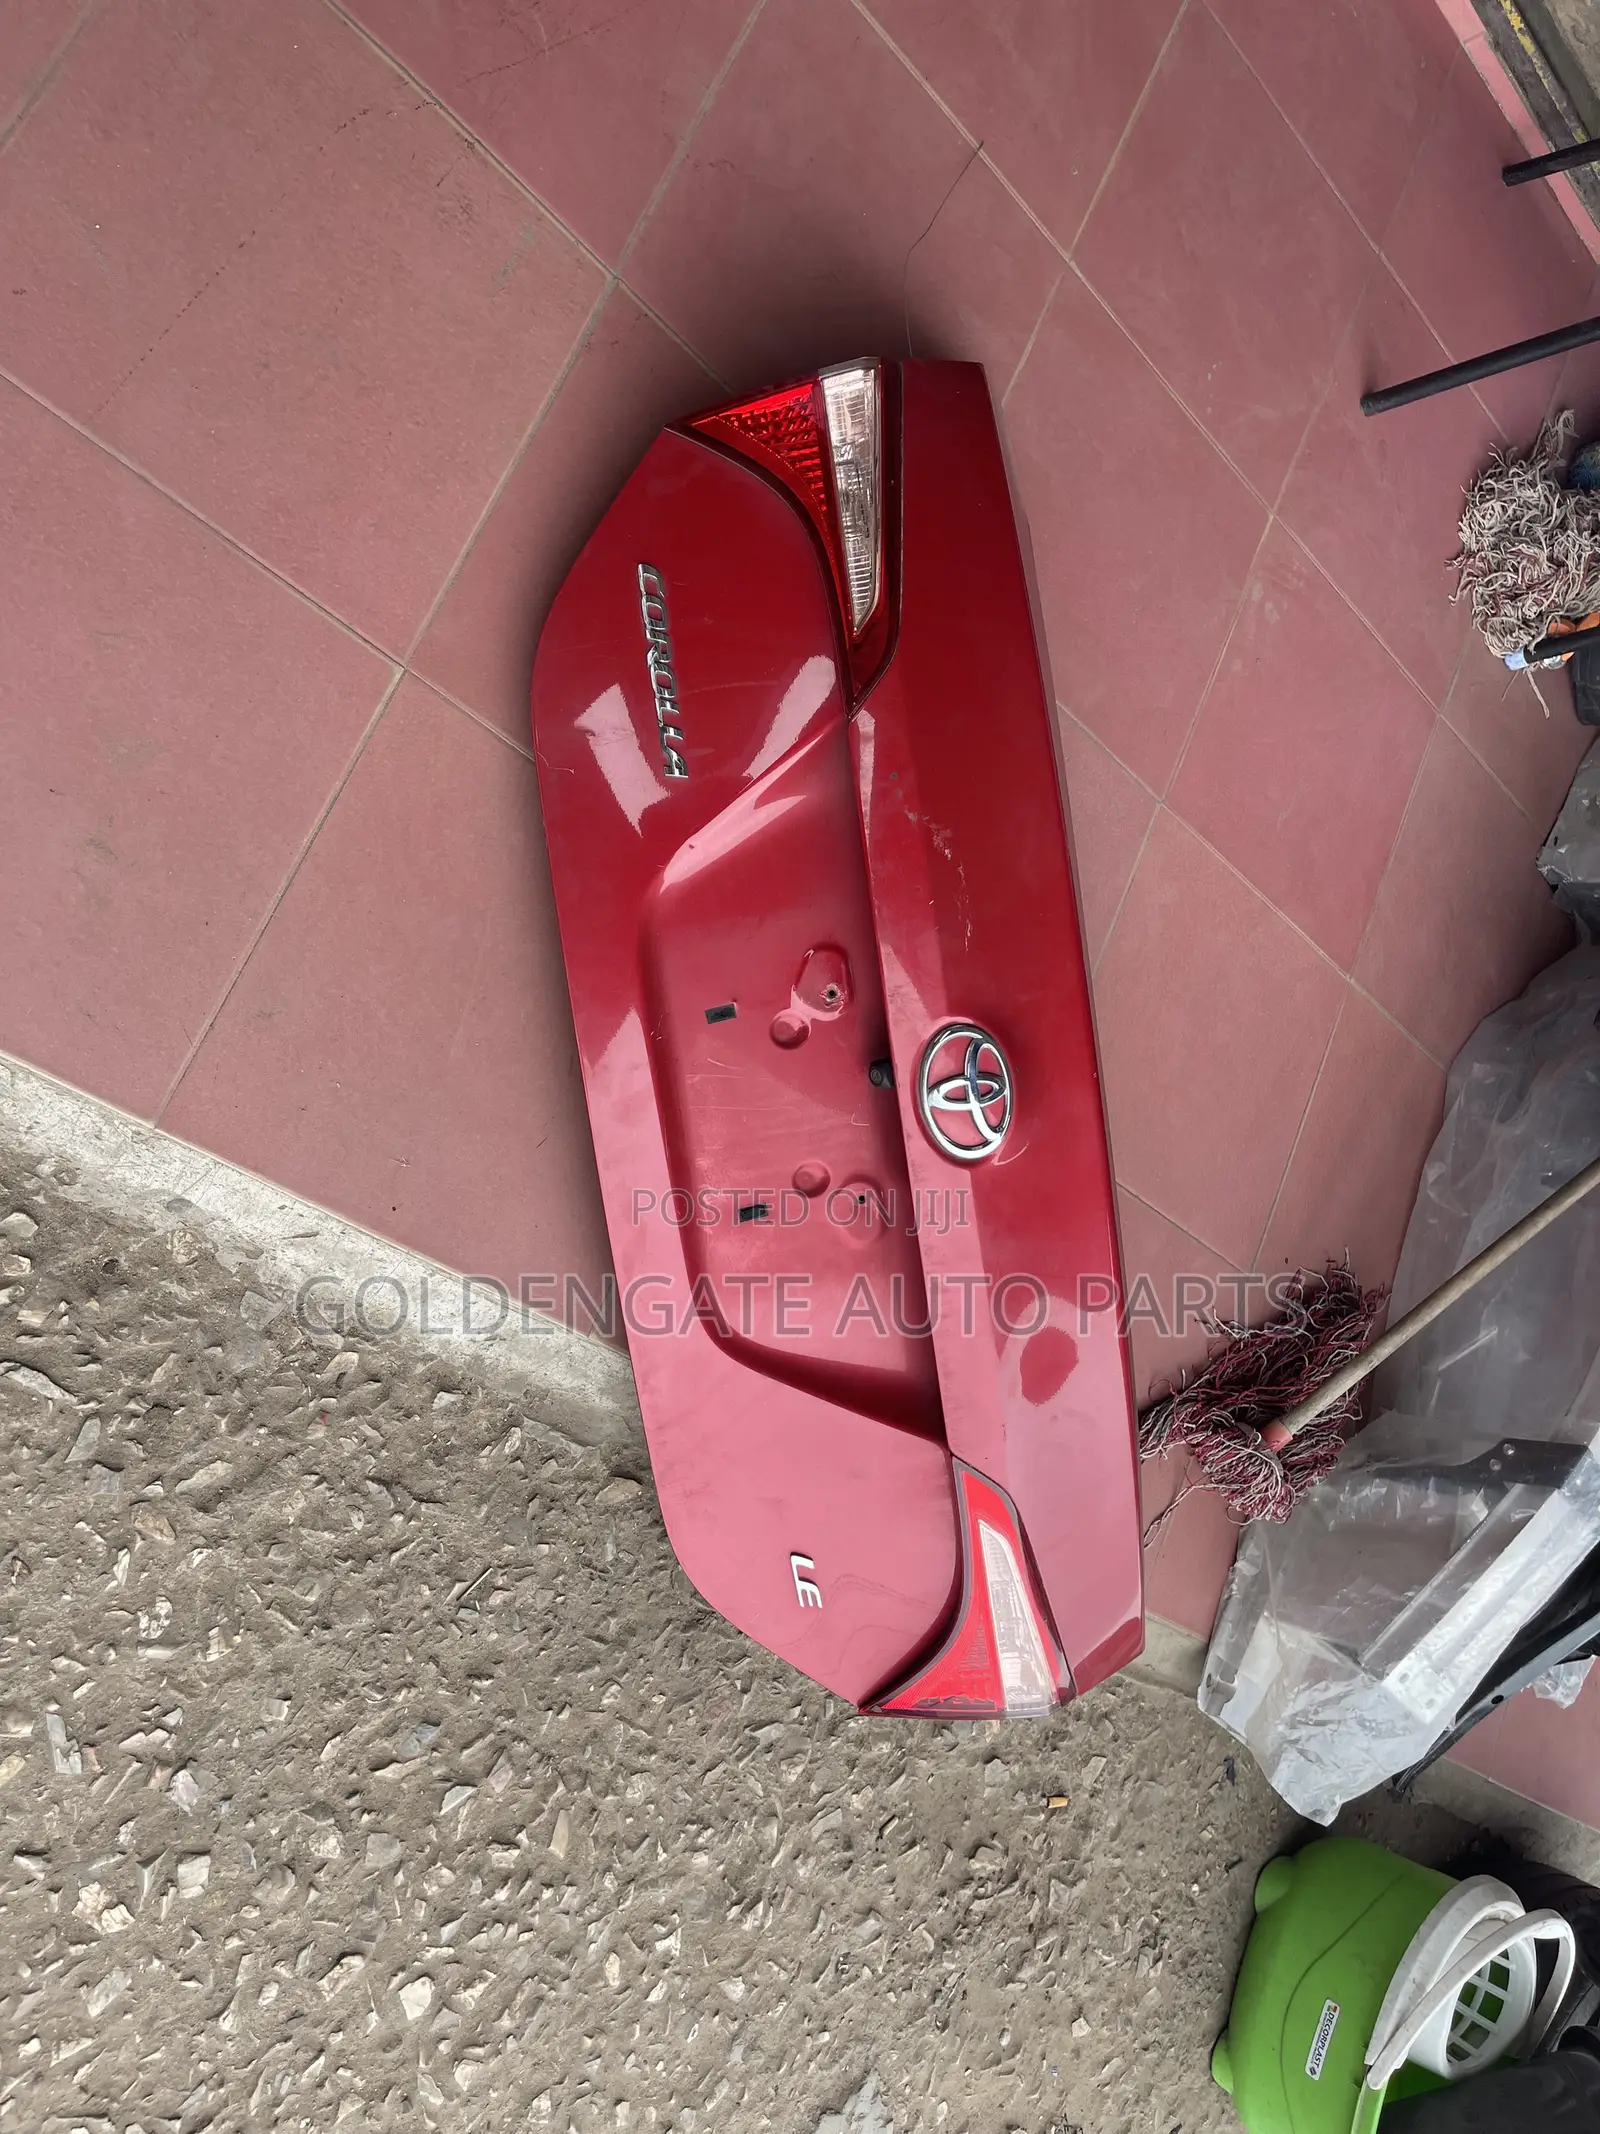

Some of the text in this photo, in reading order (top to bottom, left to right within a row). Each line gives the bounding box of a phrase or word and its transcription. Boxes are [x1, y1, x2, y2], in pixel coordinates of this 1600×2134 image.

[637, 563, 689, 778] COROLLA
[790, 1551, 823, 1609] LE
[1314, 2012, 1335, 2068] DECORPLAST
